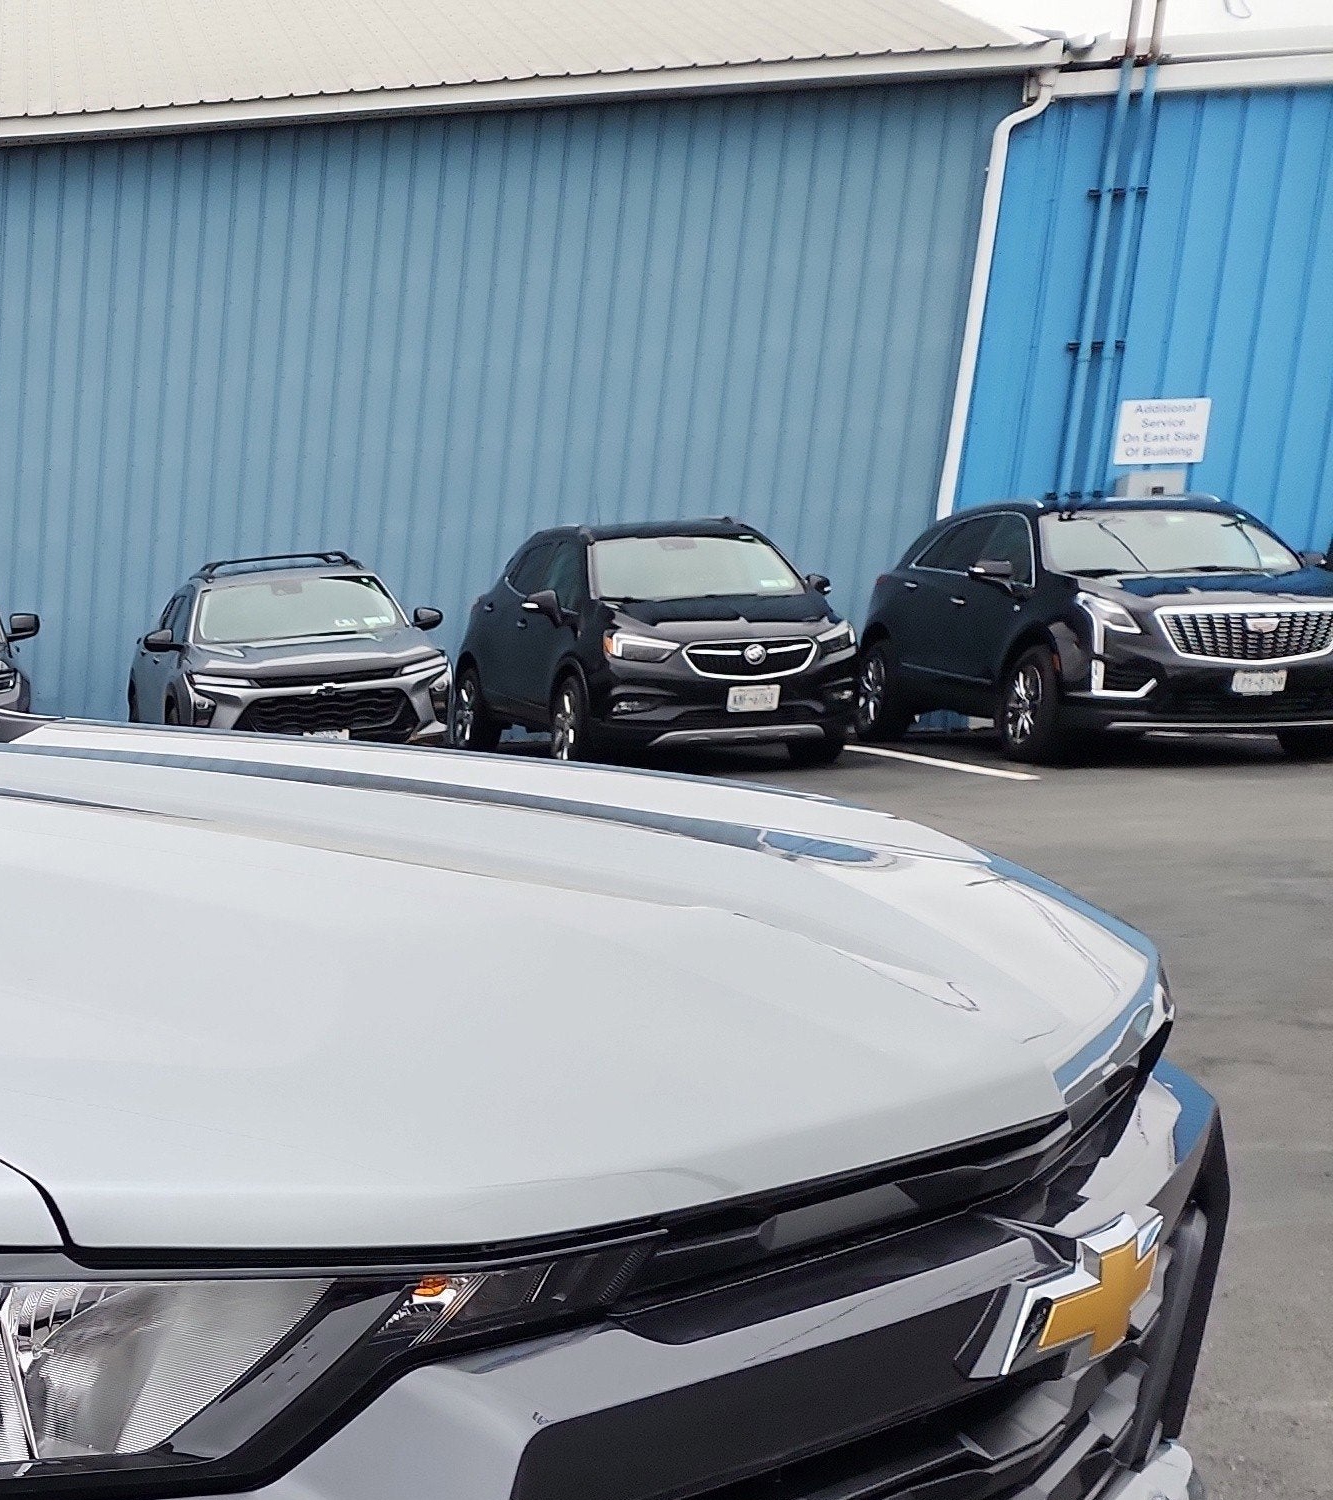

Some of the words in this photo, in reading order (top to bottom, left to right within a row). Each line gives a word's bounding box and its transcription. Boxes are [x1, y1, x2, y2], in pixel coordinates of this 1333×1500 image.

[1134, 403, 1197, 414] Additional
[1141, 418, 1186, 429] Service
[1122, 433, 1140, 443] On
[1143, 432, 1170, 442] East
[1174, 431, 1201, 441] Side
[1125, 447, 1140, 457] Of
[1143, 446, 1194, 458] Building
